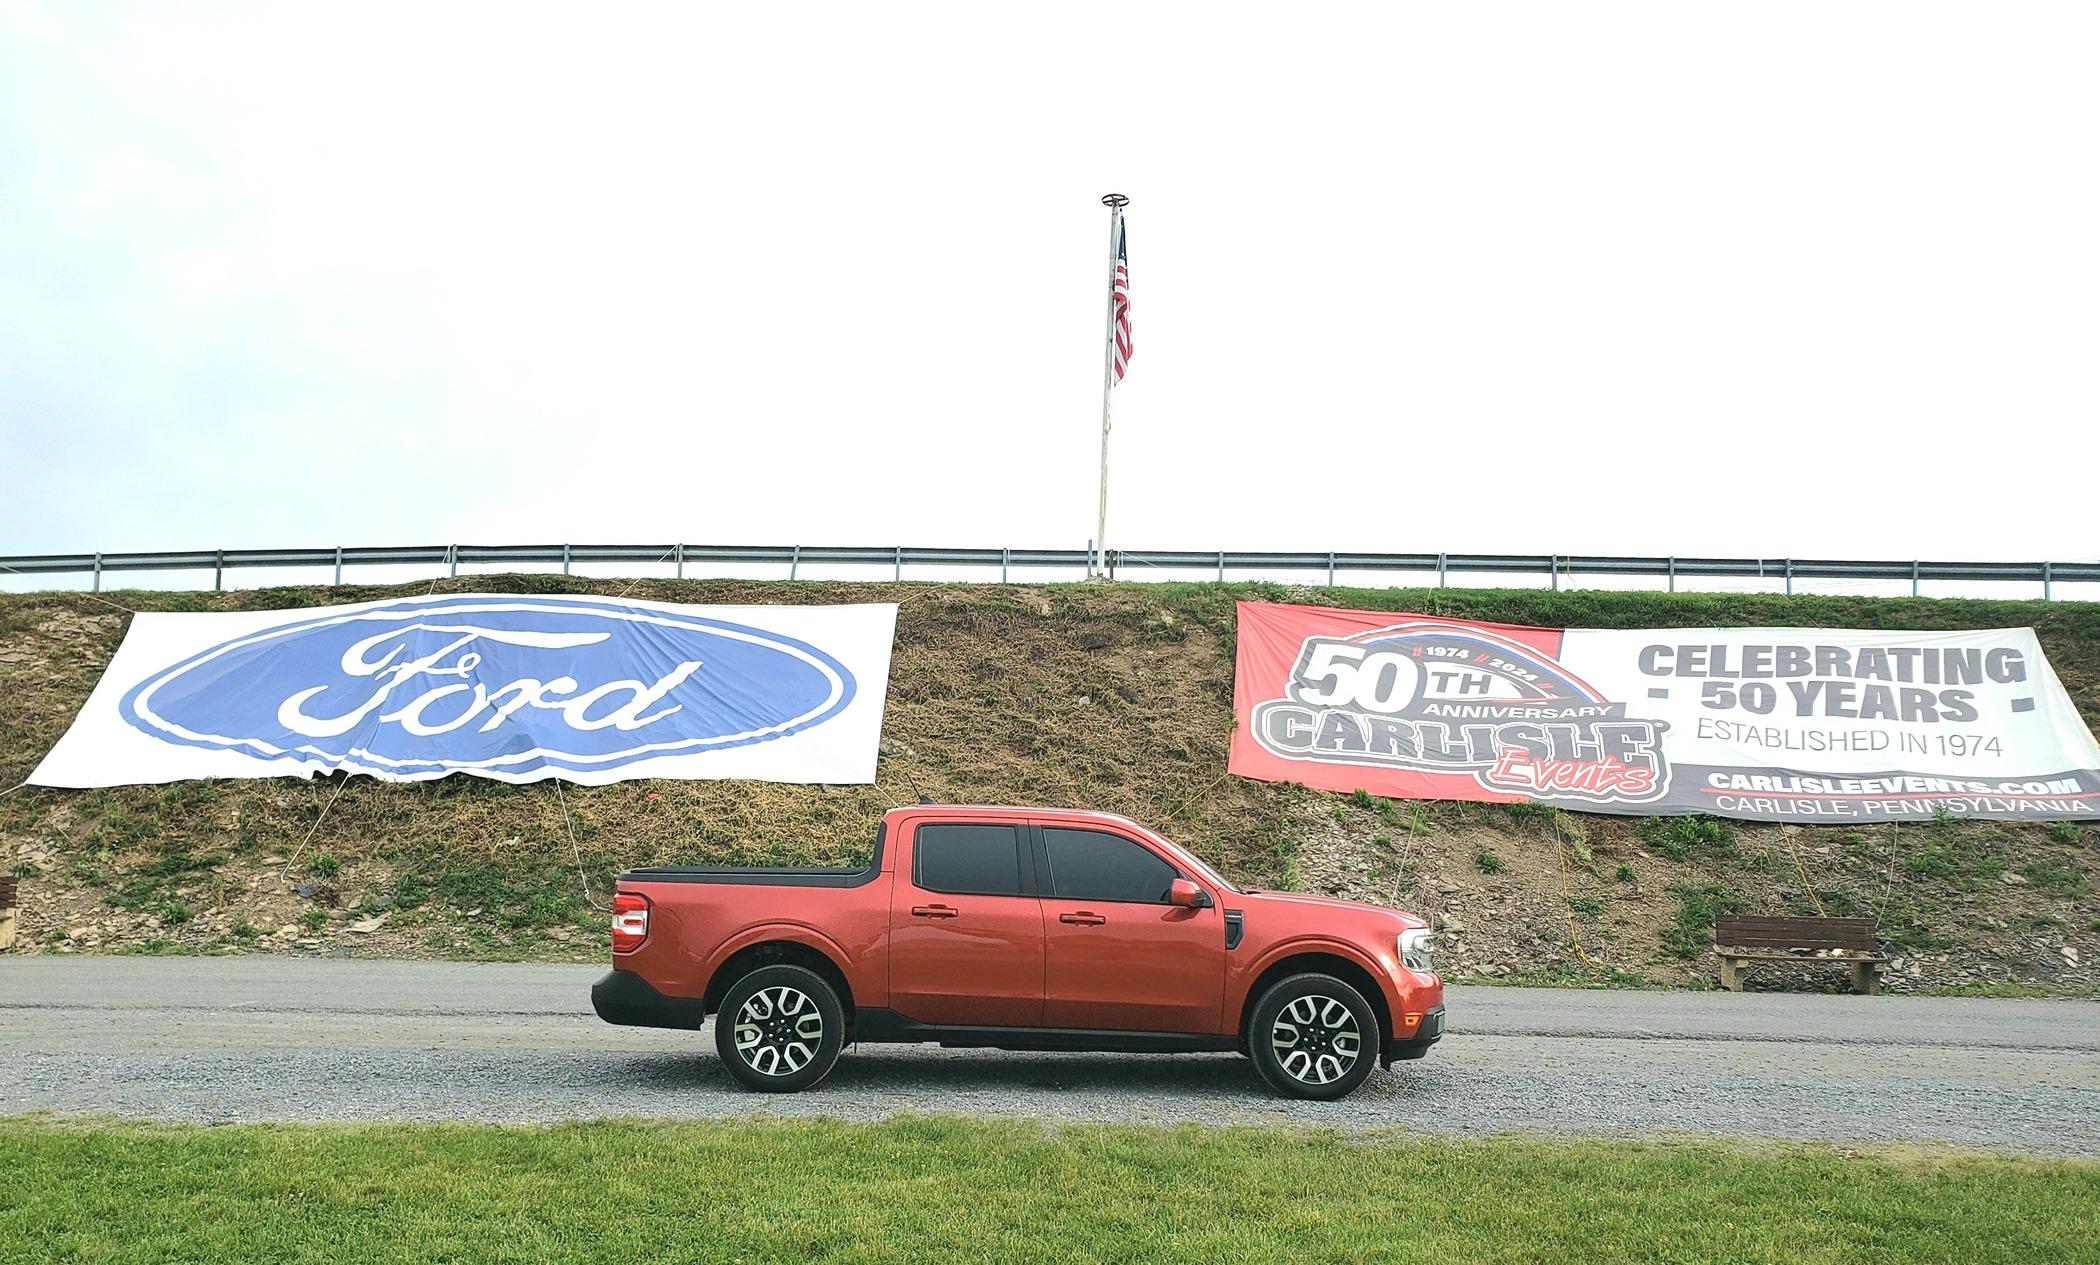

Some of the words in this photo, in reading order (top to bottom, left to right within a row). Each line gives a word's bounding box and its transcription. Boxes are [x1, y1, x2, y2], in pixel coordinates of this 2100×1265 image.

[278, 624, 703, 737] Ford
[1426, 646, 1469, 659] 1974
[1489, 658, 1539, 682] 2024
[1638, 645, 2027, 685] CELEBRATING
[1423, 703, 1613, 719] ANNIVERSARY
[1701, 681, 1776, 715] 50
[1786, 681, 1979, 722] YEARS
[1262, 705, 1655, 772] CARLISLE
[1697, 717, 1890, 752] ESTABLISHED
[1900, 731, 1927, 754] IN
[1936, 734, 2003, 757] 1974
[1489, 746, 1656, 792] Events
[1708, 772, 2082, 795] CARLISLEEVENTS.COM
[1716, 796, 1858, 816] CARLISLE,
